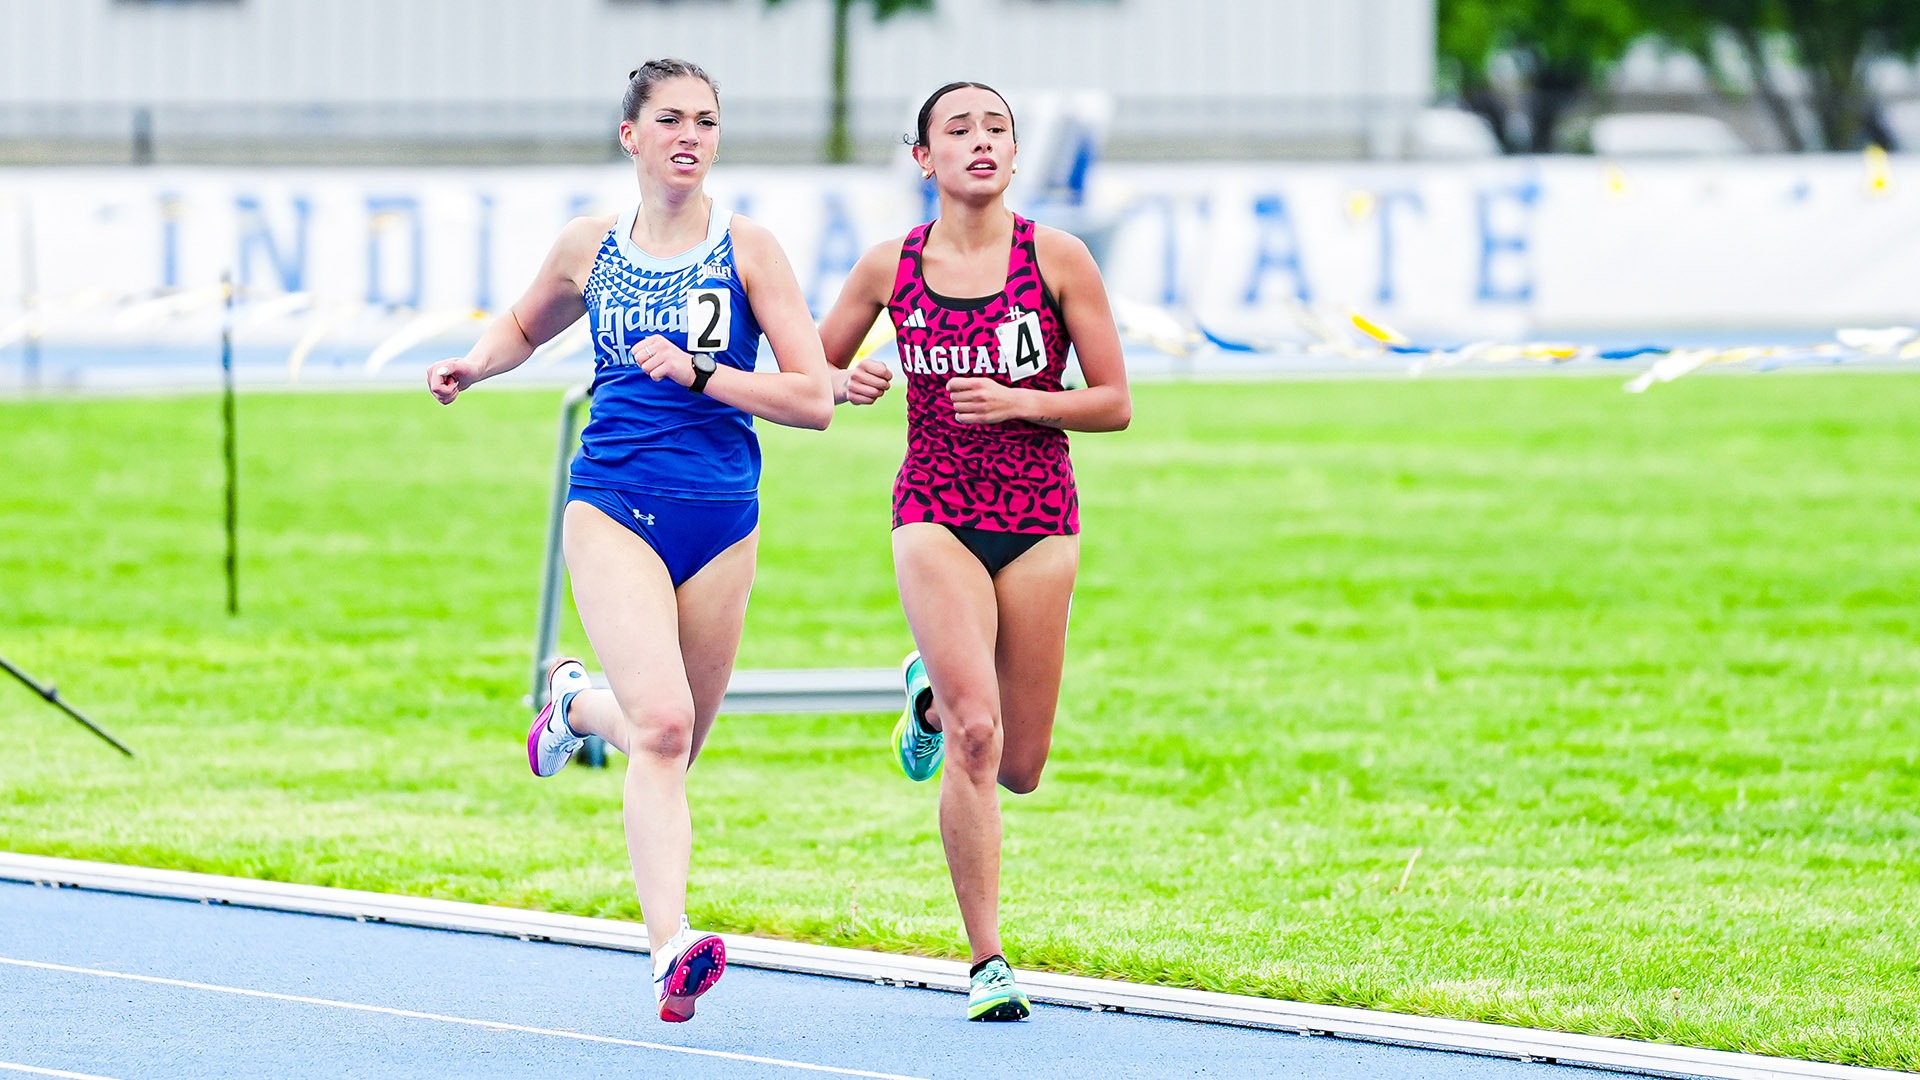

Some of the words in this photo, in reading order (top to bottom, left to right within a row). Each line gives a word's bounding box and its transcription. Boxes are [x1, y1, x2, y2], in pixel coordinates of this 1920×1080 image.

[154, 190, 872, 315] INDIA
[1126, 186, 1541, 304] TATE
[697, 293, 721, 348] 2
[1016, 321, 1040, 370] 4
